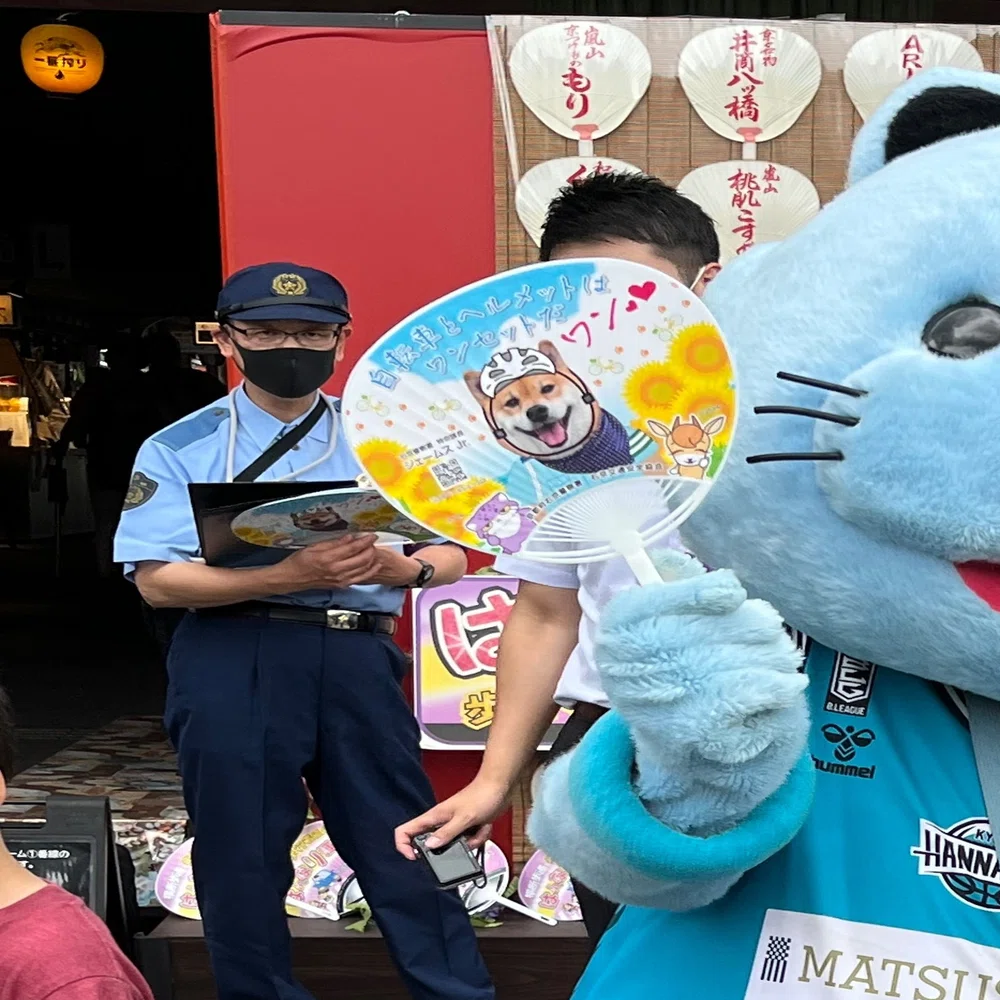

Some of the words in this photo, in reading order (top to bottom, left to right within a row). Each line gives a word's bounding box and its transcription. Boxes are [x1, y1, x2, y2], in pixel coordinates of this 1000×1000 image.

[561, 67, 591, 119] もり
[369, 274, 613, 392] 自転車とヘルメットは
[425, 302, 568, 374] ワンセットだ
[825, 701, 866, 716] B.LEAGUE
